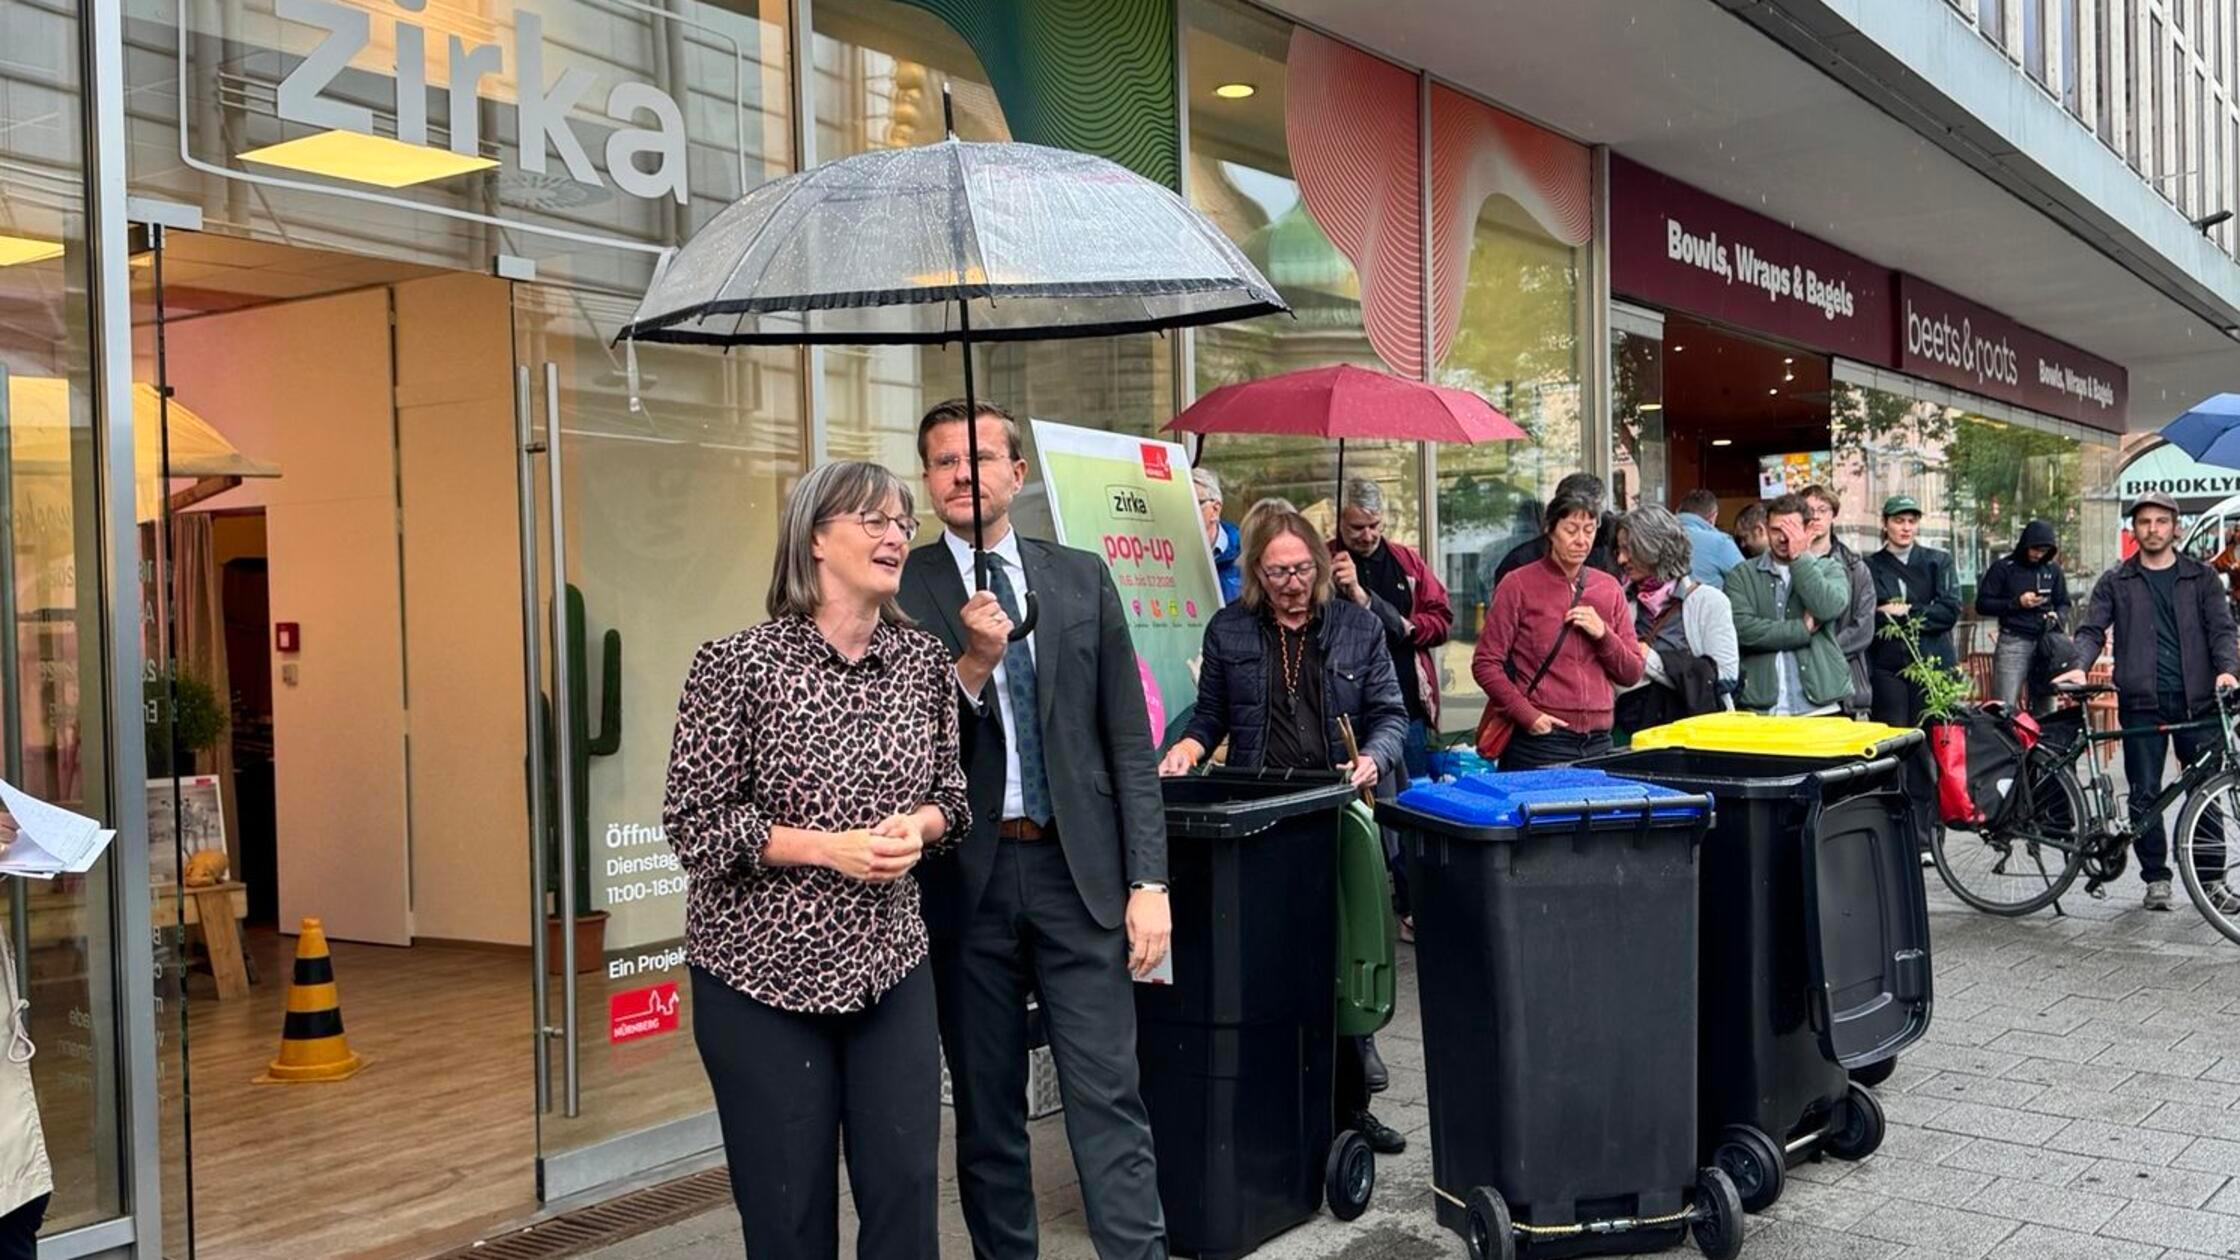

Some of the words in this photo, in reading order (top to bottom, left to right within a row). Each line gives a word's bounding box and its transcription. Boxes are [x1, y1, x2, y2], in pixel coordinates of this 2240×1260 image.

[276, 0, 688, 205] zirka
[1667, 218, 1733, 285] Bowls,
[1735, 243, 1791, 302] Wraps
[1793, 265, 1804, 301] &
[1806, 269, 1854, 320] Bagels
[1113, 491, 1147, 514] zirka
[1103, 534, 1175, 569] pop-up
[606, 852, 679, 877] Dienstag
[608, 959, 634, 979] Ein
[613, 1018, 660, 1038] NÜRNBERG
